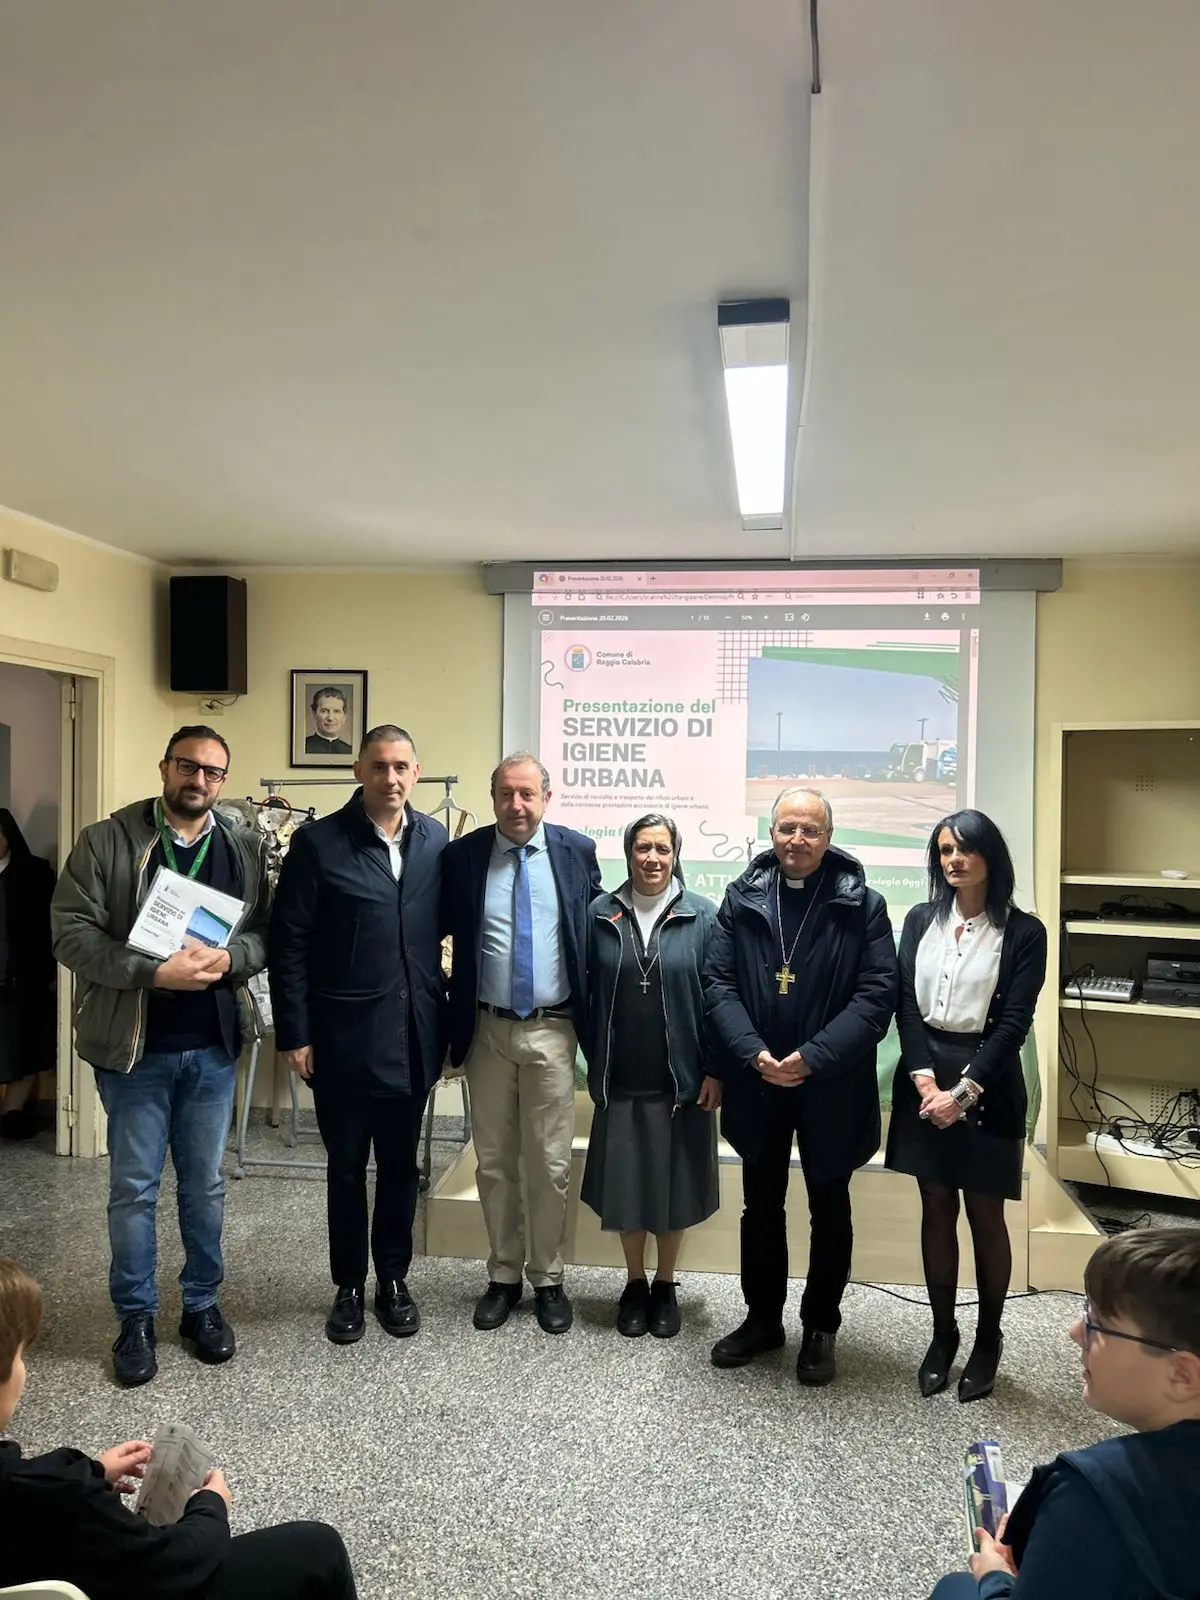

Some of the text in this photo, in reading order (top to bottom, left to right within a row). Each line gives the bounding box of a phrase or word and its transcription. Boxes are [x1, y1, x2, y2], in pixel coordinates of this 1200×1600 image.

[626, 650, 633, 658] di
[596, 659, 621, 667] Reggio
[563, 698, 716, 714] Presentazione del
[562, 717, 713, 737] SERVIZIO DI
[562, 742, 646, 763] IGIENE
[562, 767, 665, 788] URBANA
[902, 877, 924, 889] Oggi
